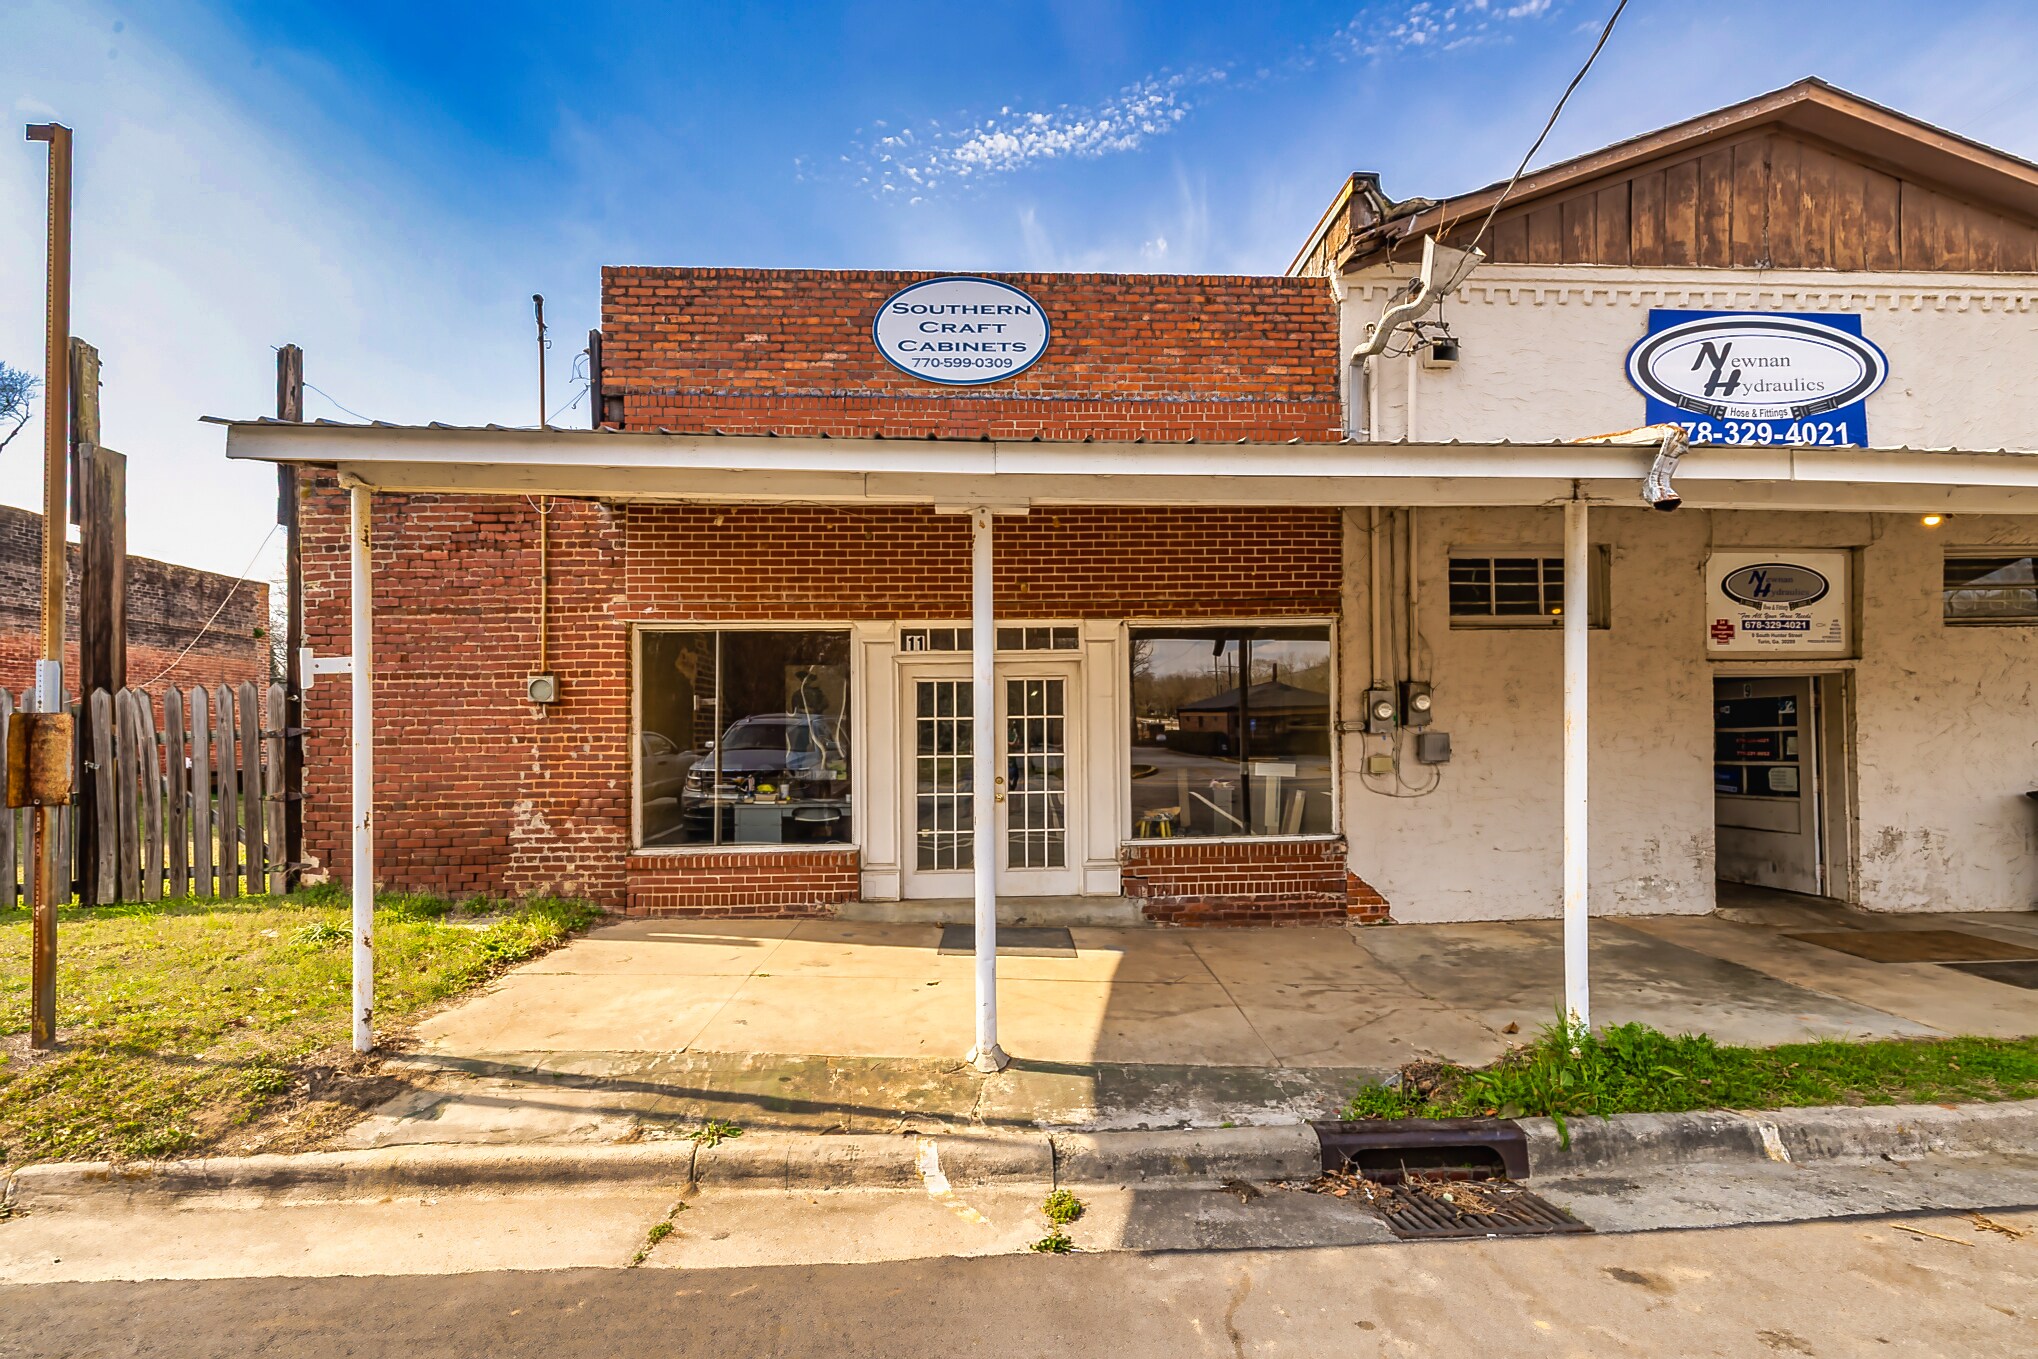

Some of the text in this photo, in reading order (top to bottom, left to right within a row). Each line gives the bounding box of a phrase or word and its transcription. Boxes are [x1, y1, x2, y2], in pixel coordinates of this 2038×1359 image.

[892, 302, 1031, 315] SOUTHERN
[919, 321, 1007, 333] CRAFT
[897, 340, 1027, 352] CABINETS
[1691, 341, 1791, 371] Newnan
[911, 357, 1013, 368] 770-599-0309
[1704, 369, 1825, 397] Hydraulics
[1730, 407, 1788, 418] Hose & Fittings
[1667, 421, 1848, 445] 78-329-4021
[1745, 621, 1806, 629] 678-329-4021
[908, 636, 924, 651] 11
[1744, 685, 1751, 697] 9
